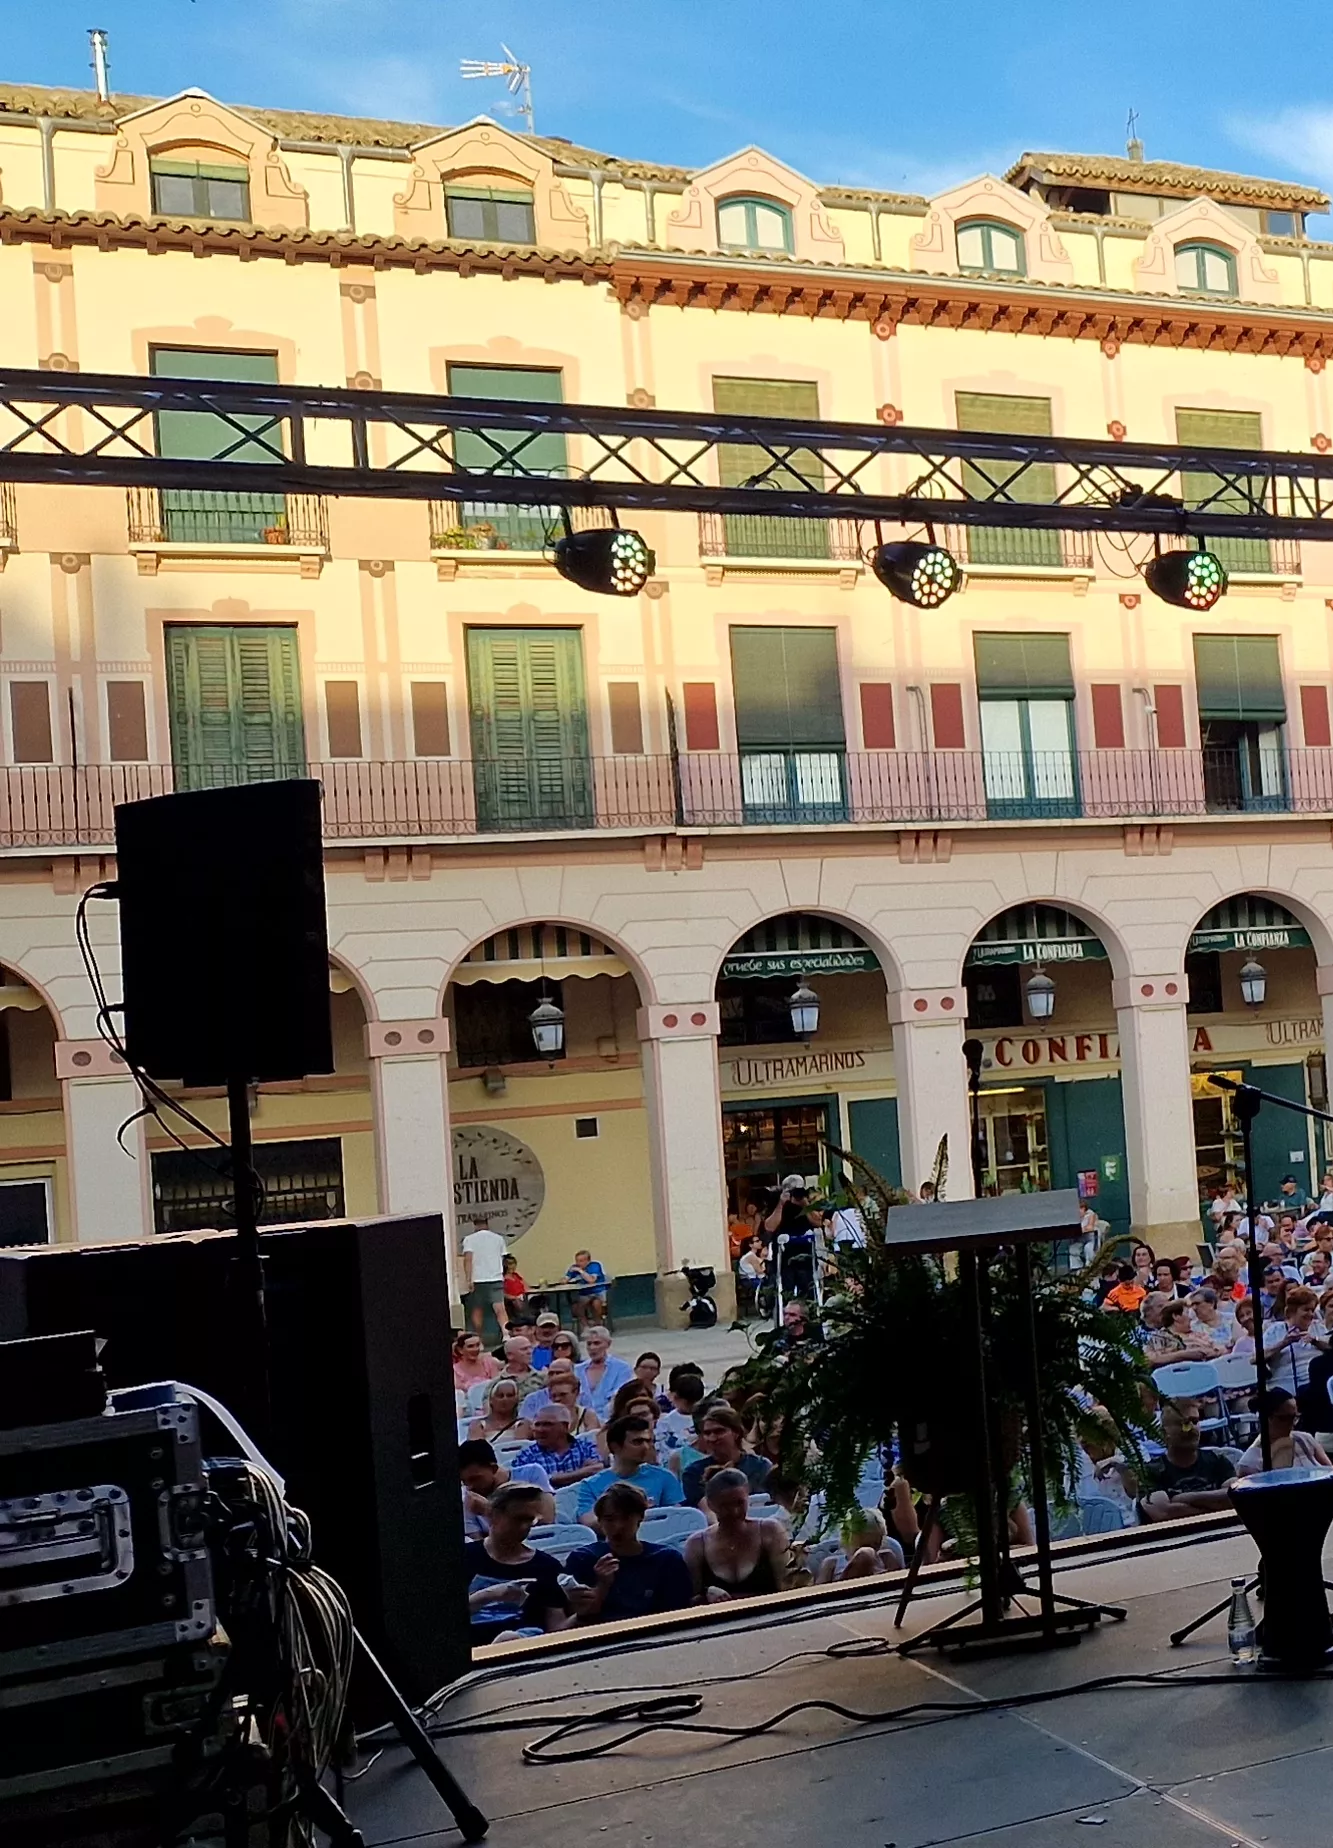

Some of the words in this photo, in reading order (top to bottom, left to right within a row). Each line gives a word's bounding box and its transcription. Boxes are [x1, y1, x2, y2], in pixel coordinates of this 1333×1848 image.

[1233, 931, 1246, 948] LA
[1246, 930, 1290, 948] CONFIANZA
[1022, 943, 1035, 961] LA
[1036, 942, 1084, 960] CONFIANZA
[722, 957, 764, 976] pruebe
[766, 958, 786, 971] sus
[789, 953, 866, 973] especialidades
[735, 1051, 866, 1086] ULTRAMARINOS
[458, 1154, 479, 1180] LA
[453, 1177, 520, 1205] STIENDA
